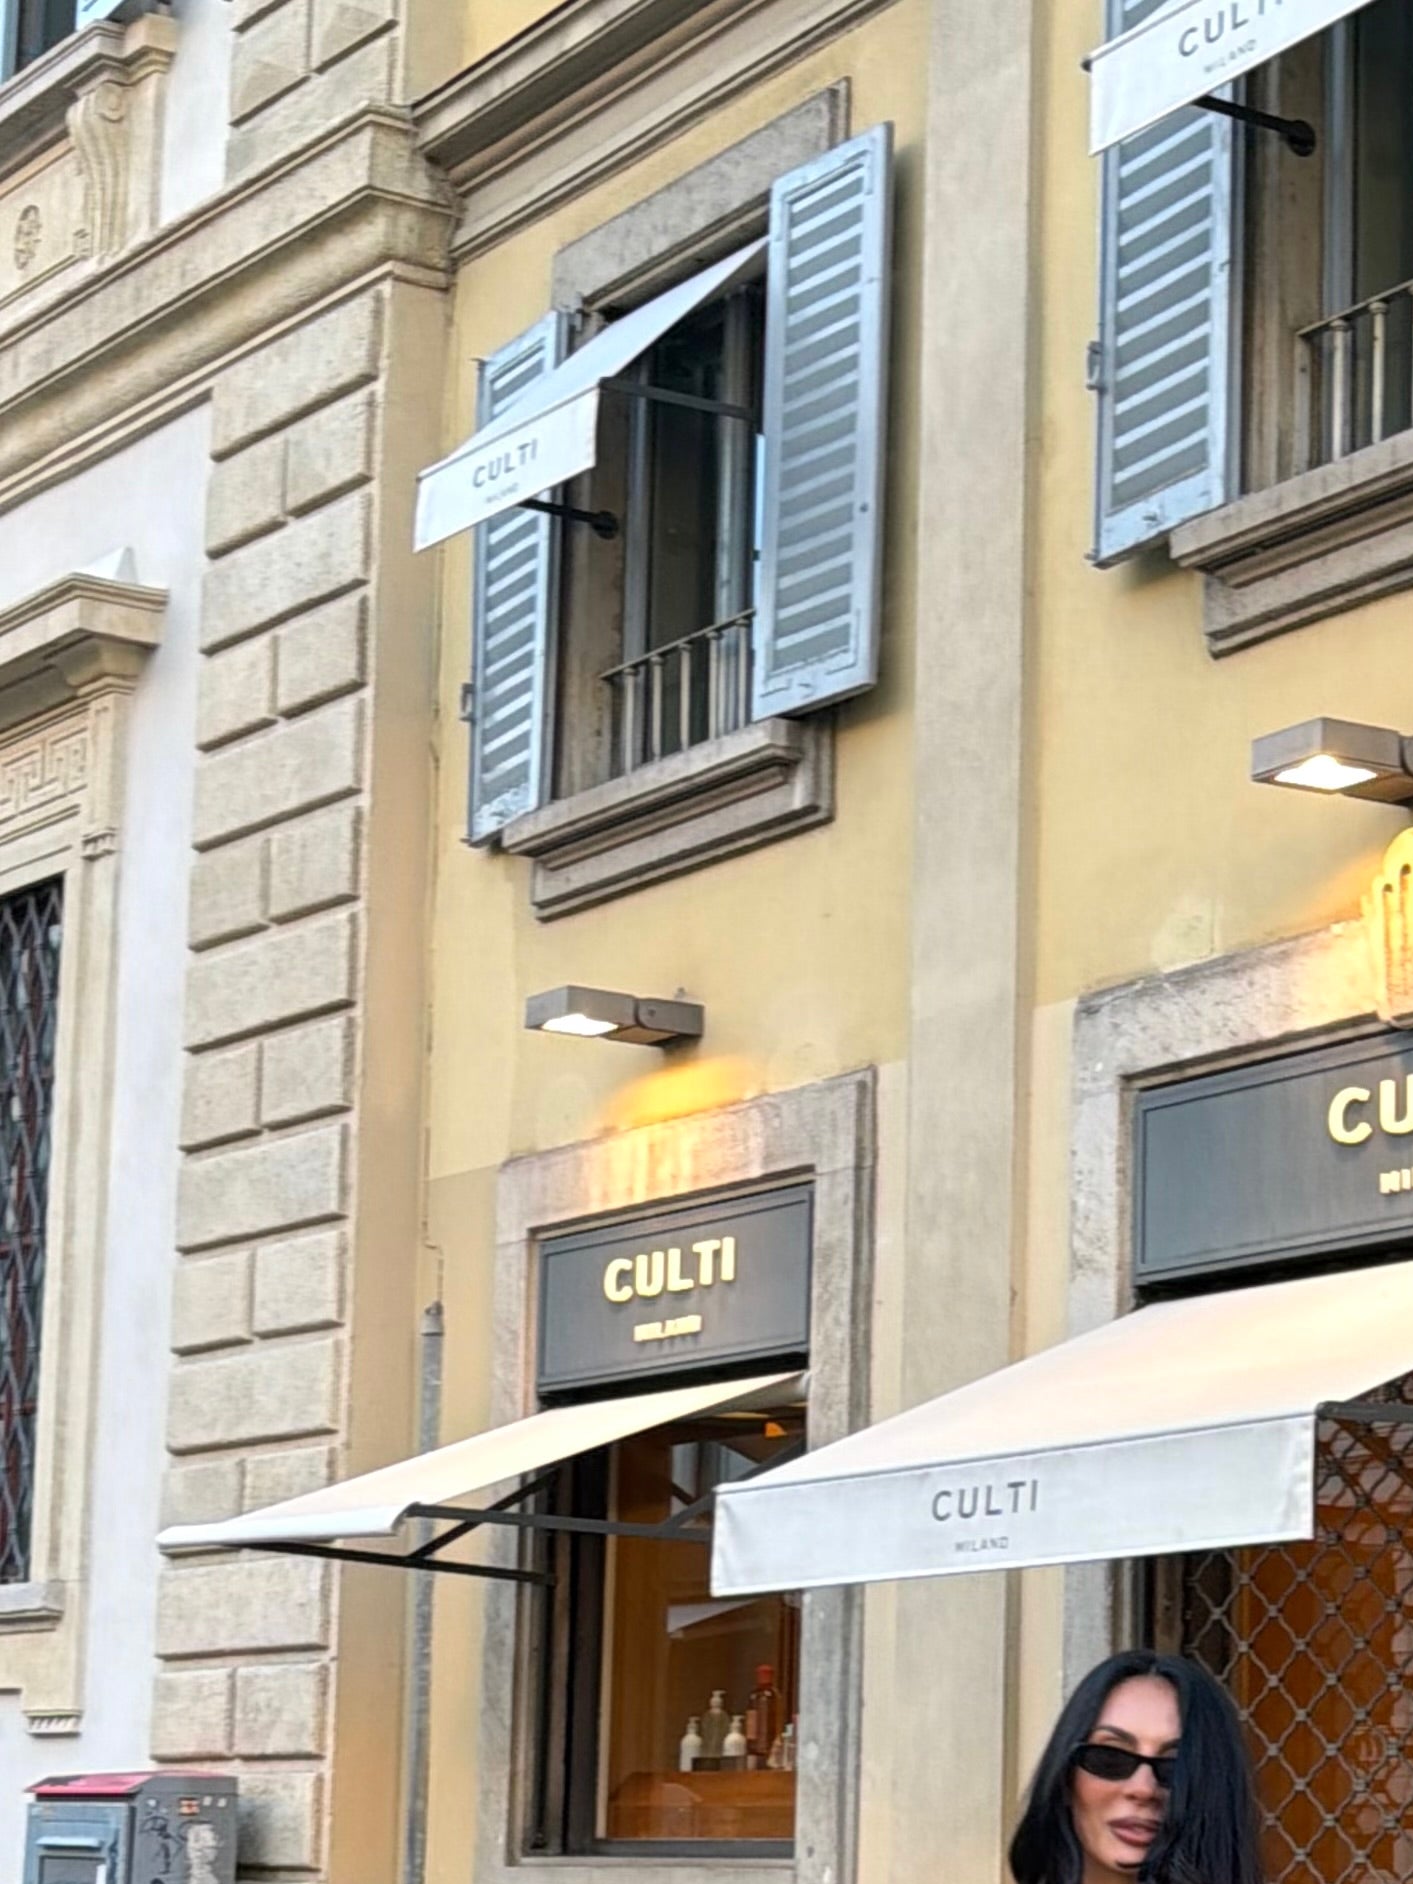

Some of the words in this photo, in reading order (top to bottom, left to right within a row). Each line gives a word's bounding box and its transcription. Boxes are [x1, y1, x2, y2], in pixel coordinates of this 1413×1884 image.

[473, 438, 538, 488] CULTI
[603, 1236, 736, 1302] CULTI
[931, 1479, 1038, 1521] CULTI
